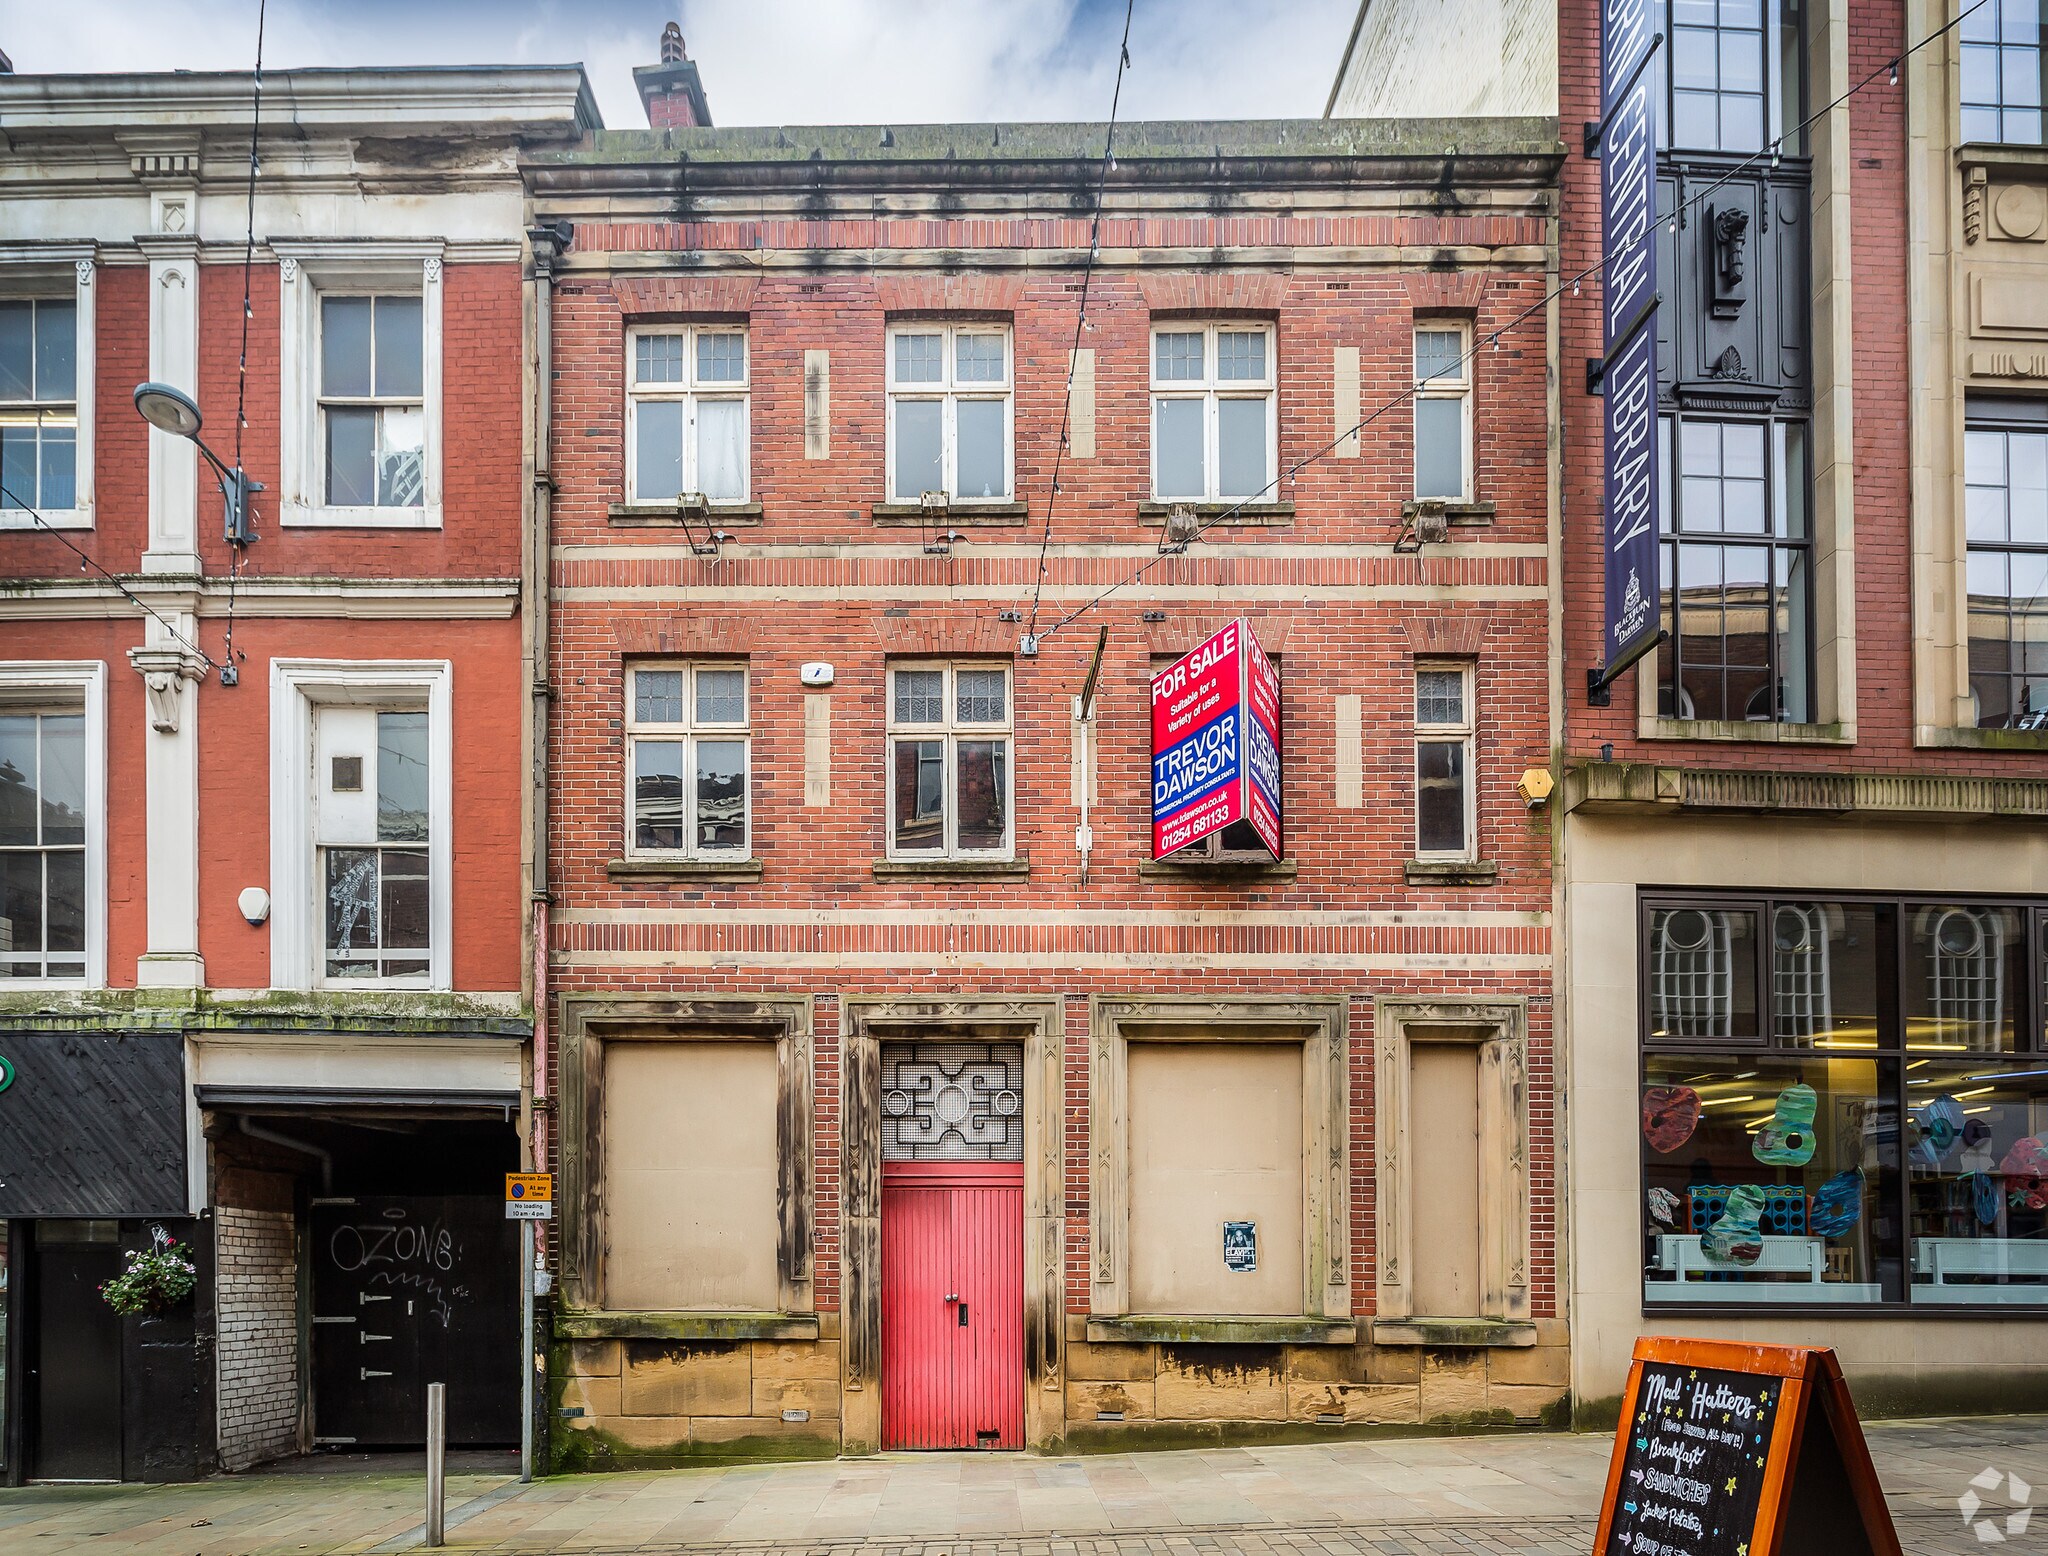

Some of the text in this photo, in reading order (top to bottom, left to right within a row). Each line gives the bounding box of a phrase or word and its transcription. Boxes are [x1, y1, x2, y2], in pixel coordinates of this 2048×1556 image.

[1608, 84, 1647, 338] CENTRAL
[1611, 330, 1650, 553] LIBRARY
[1152, 628, 1236, 706] FOR SALE
[1167, 692, 1221, 733] Variety of uses
[1170, 677, 1217, 716] Suitable for a
[1154, 714, 1235, 780] TREVOR
[1154, 766, 1236, 817] COMMERCIAL PROPERTY CONSULTANTS
[1155, 737, 1236, 805] DAWSON
[1161, 790, 1229, 833] www.tdawson.co.uk
[1161, 824, 1192, 851] 01254
[1193, 804, 1229, 835] 681133
[1645, 1373, 1757, 1420] Mad Hatters
[1649, 1436, 1707, 1475] Breakfast
[1706, 1428, 1720, 1441] ALL
[1644, 1467, 1711, 1506] SANDWICHES
